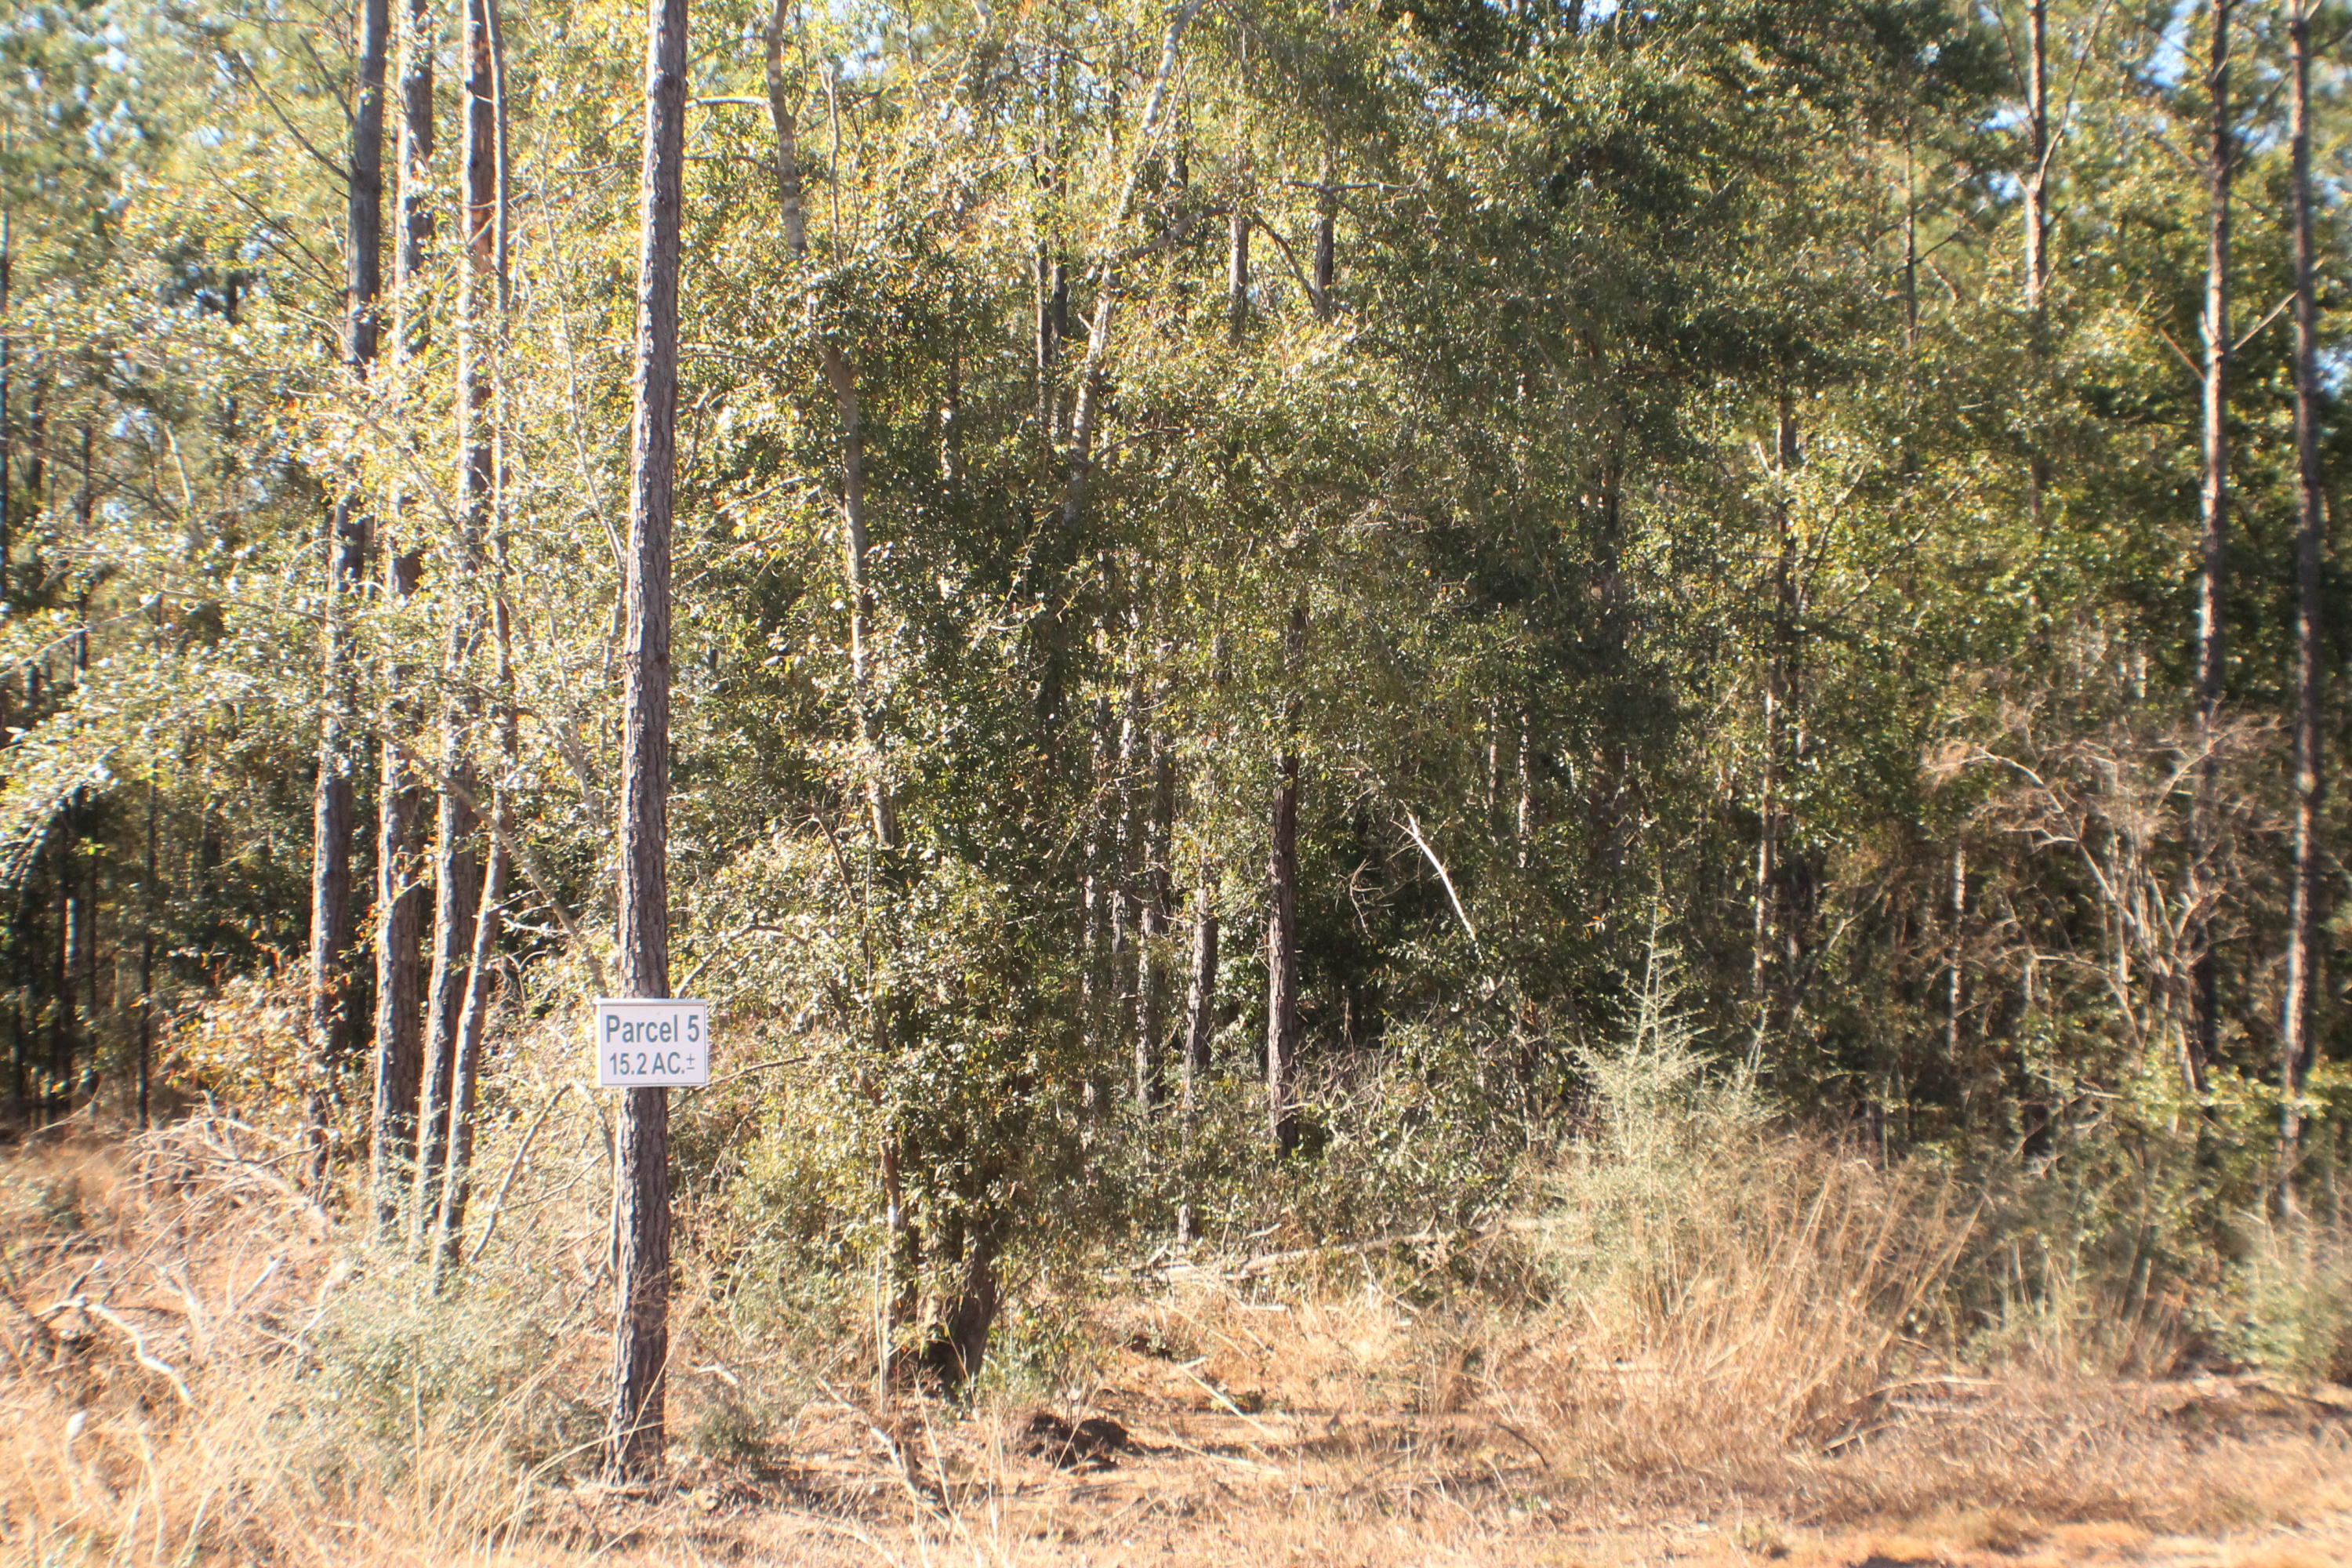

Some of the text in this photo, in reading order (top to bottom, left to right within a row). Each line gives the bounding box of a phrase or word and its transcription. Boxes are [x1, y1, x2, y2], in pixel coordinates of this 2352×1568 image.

[606, 1014, 699, 1043] Parcel 5
[609, 1052, 647, 1075] 15.2
